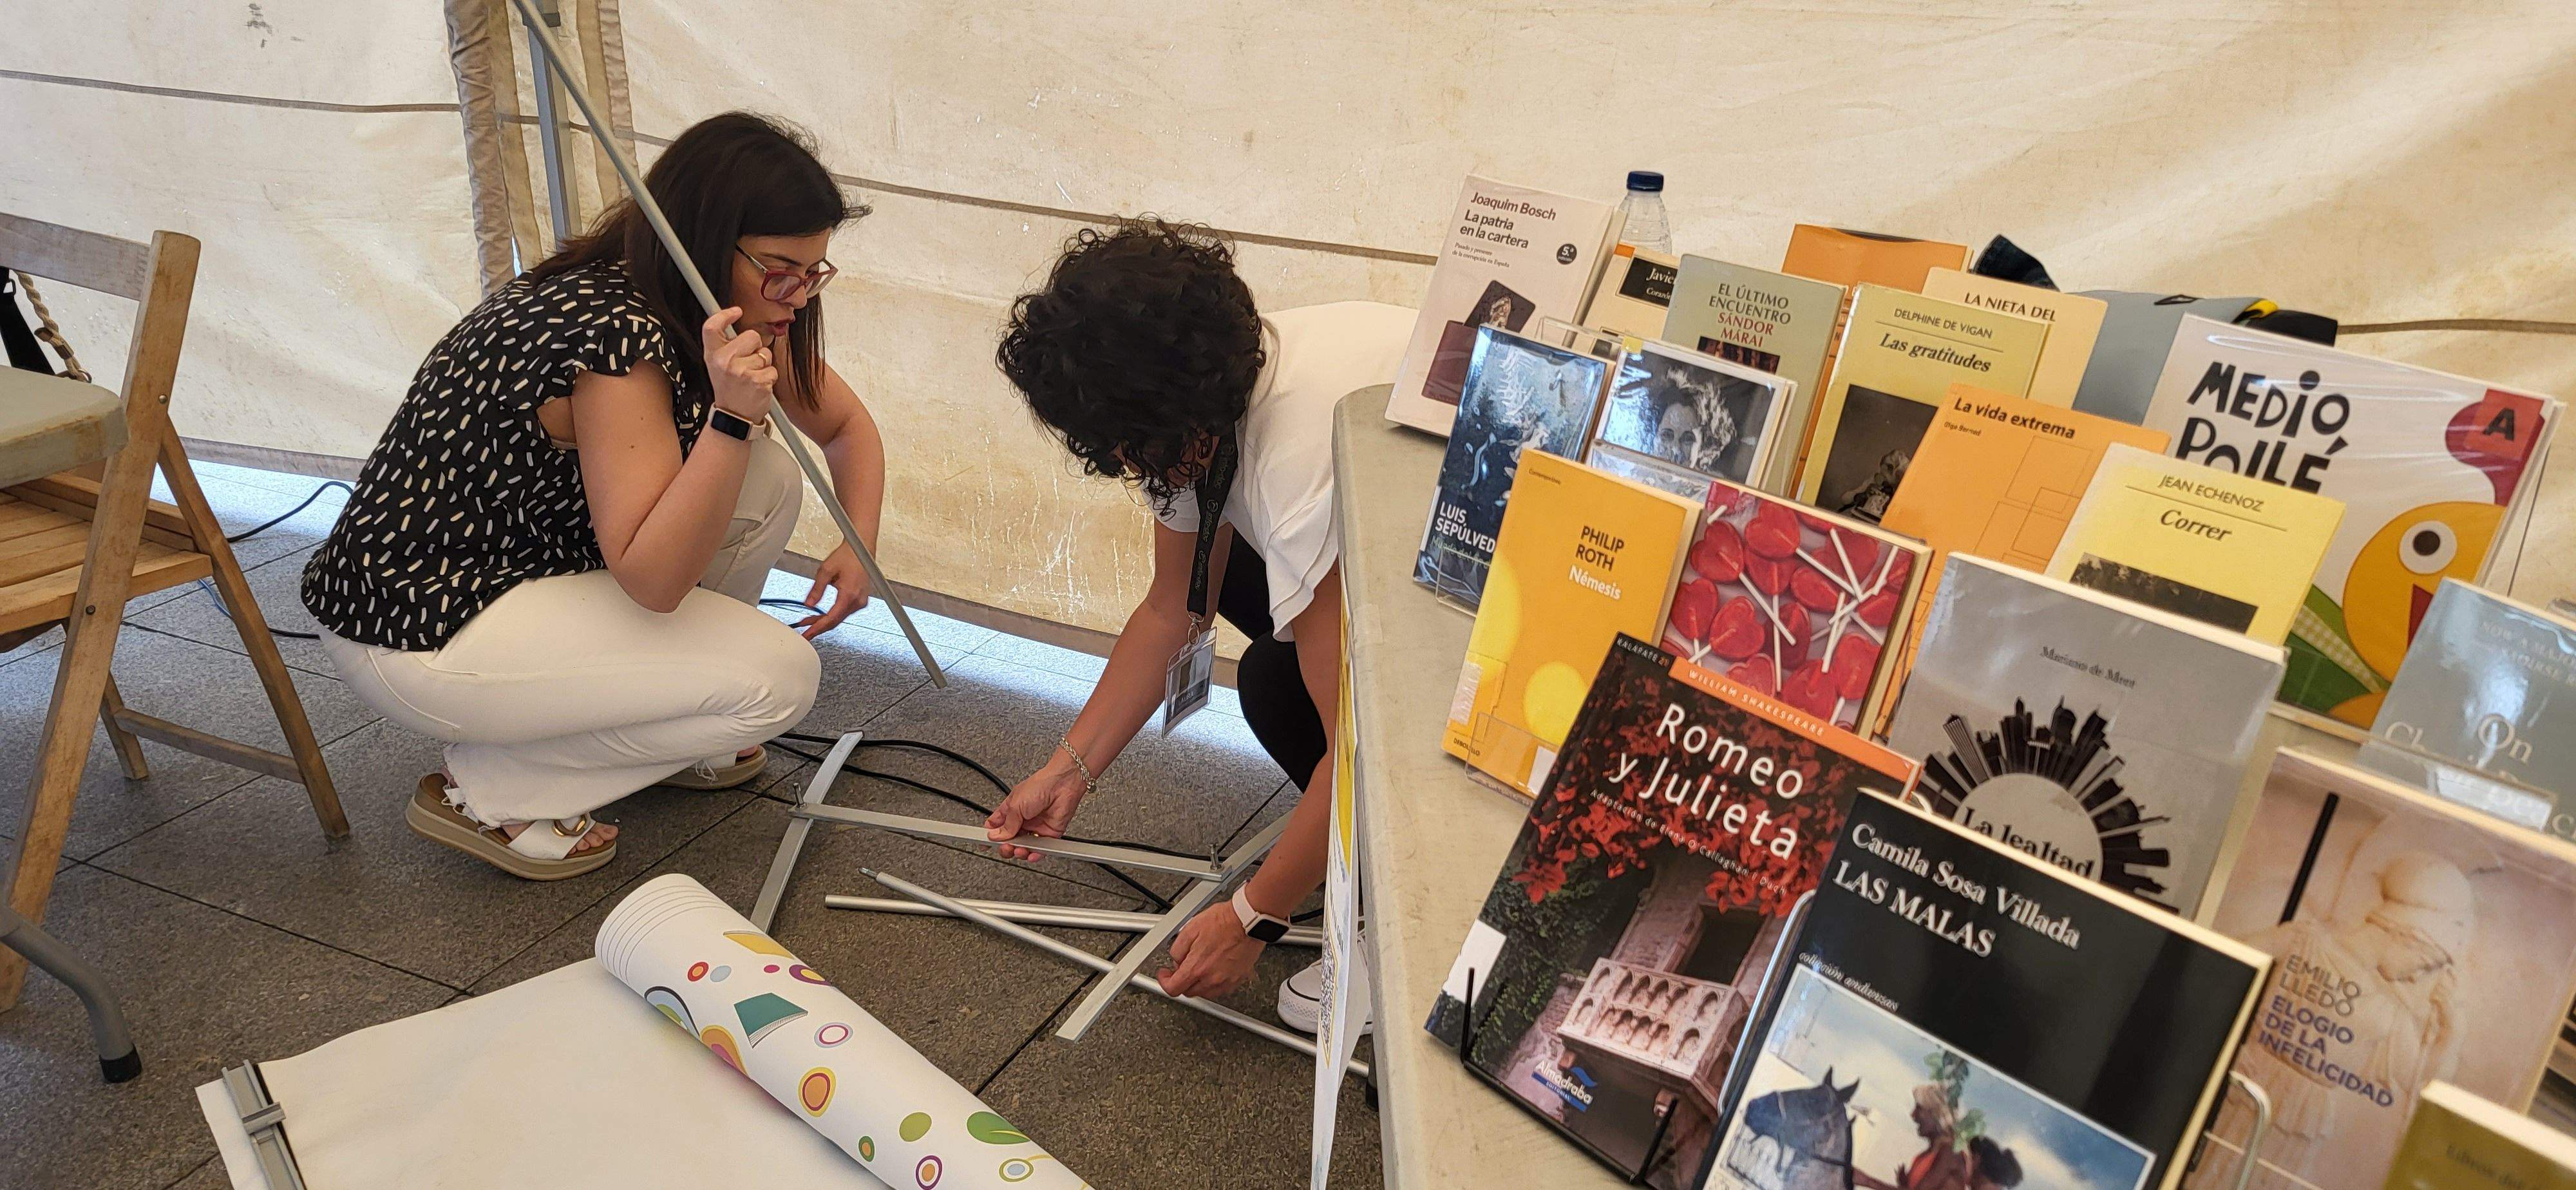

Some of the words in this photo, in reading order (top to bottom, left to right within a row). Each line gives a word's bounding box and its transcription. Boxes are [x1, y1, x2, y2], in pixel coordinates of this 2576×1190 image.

[1464, 209, 1479, 222] La
[1479, 214, 1514, 231] patria
[1470, 192, 1518, 212] Joaquim
[1519, 202, 1556, 221] Bosch
[1460, 225, 1474, 236] en
[1475, 225, 1486, 239] la
[1487, 232, 1529, 249] cartera
[1646, 267, 1676, 284] Javie
[1709, 296, 1791, 325] ENCUENTRO
[1718, 283, 1731, 296] EL
[1736, 283, 1788, 309] ÚLTIMO
[1964, 292, 1980, 305] LA
[1984, 296, 2026, 316] NIETA
[2030, 306, 2056, 321] DEL
[1718, 311, 1774, 335] SÁNDOR
[1720, 327, 1763, 348] MÁRAI
[1894, 308, 1940, 327] DELPHINE
[1943, 319, 1956, 331] DE
[1956, 323, 1993, 339] VIGAN
[1879, 332, 1909, 352] Las
[1908, 344, 1991, 373] gratitudes
[1944, 421, 1958, 430] Olga
[1953, 397, 1972, 413] La
[1975, 403, 2007, 422] vida
[2010, 414, 2076, 439] extrema
[2482, 408, 2516, 442] A
[2157, 475, 2194, 493] JEAN
[2194, 484, 2264, 513] ECHENOZ
[1439, 501, 1467, 524] LUIS
[2161, 509, 2233, 542] Correr
[1435, 517, 1496, 553] SEPÚLVED
[1580, 525, 1624, 553] PHILIP
[1575, 543, 1615, 572] ROTH
[1569, 565, 1622, 600] Némesis
[1689, 669, 1737, 697] WILLIAM
[1741, 694, 1825, 737] SHAKESPEARE
[1656, 703, 1803, 800] Romeo
[2478, 714, 2533, 764] On
[1590, 788, 1643, 822] Adaptación
[1645, 817, 1658, 828] de
[1659, 824, 1685, 843] Elena
[1609, 752, 1639, 784] y
[1638, 756, 1797, 861] Julieta
[2001, 824, 2094, 878] lealtad
[1852, 822, 1931, 879] Camila
[1932, 860, 1987, 906] Sosa
[1996, 885, 2082, 951] Villada
[1832, 859, 1889, 905] LAS
[1888, 885, 1996, 958] MALAS
[2286, 954, 2362, 999] EMILIO
[2266, 1012, 2296, 1038] DE
[2298, 1029, 2327, 1055] LA
[2272, 995, 2355, 1044] ELOGIO
[1535, 1059, 1595, 1105] Almadraba
[2258, 1030, 2394, 1108] INFELICIDAD
